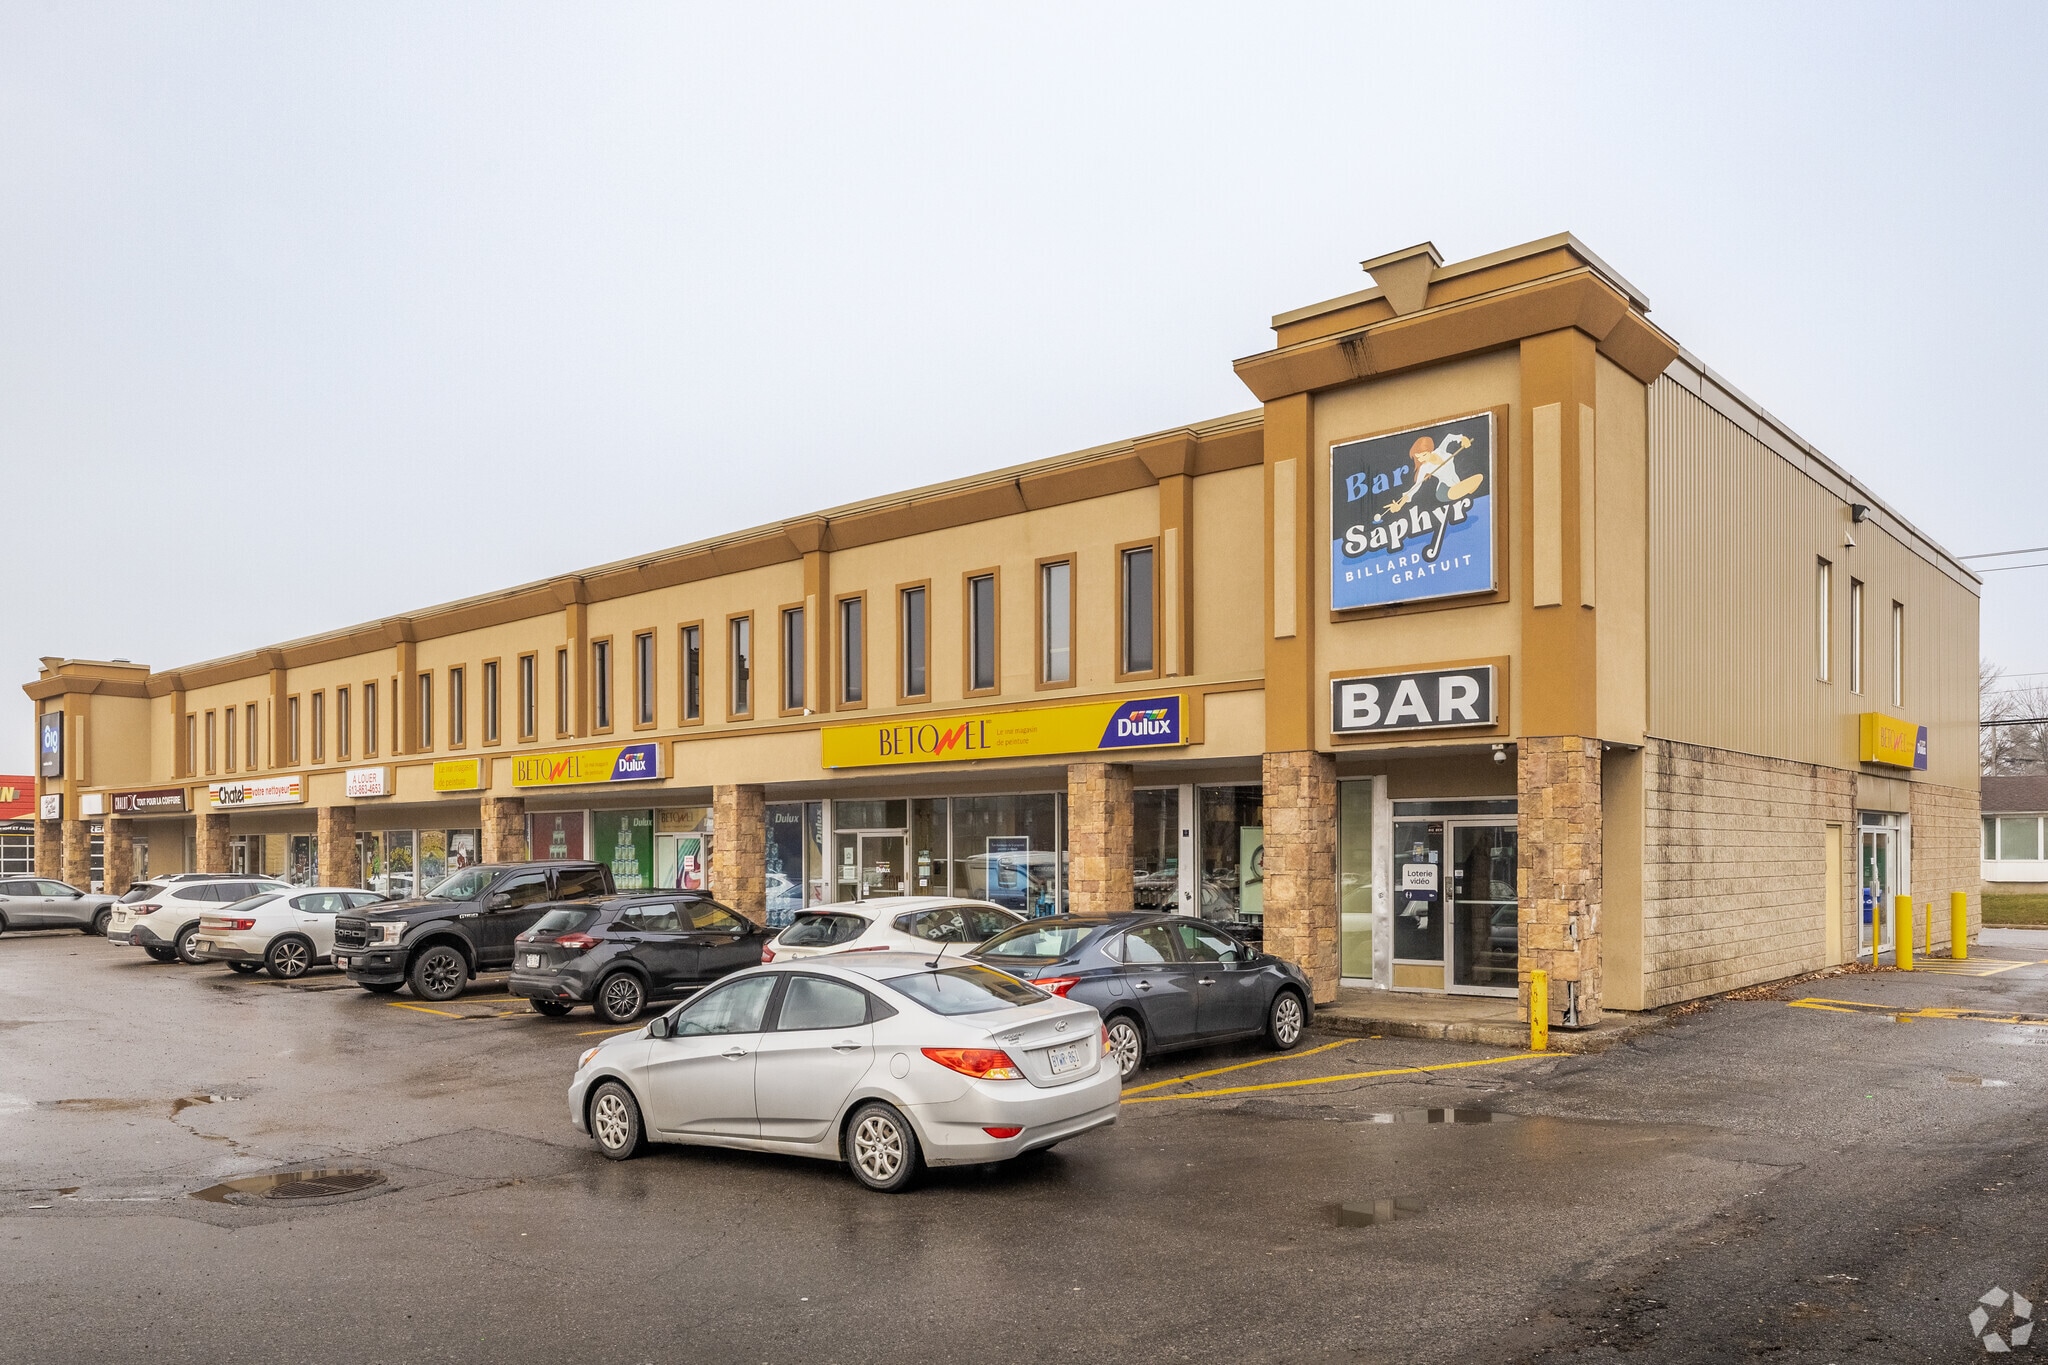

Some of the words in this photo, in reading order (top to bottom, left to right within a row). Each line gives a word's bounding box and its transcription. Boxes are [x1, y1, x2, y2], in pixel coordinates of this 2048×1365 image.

[1345, 464, 1409, 503] Bar
[1345, 497, 1472, 560] Saphyr
[1345, 553, 1420, 582] BILLARD
[1392, 554, 1471, 584] GRATUIT
[1341, 675, 1480, 728] BAR
[1014, 726, 1038, 736] magasin
[1117, 717, 1171, 737] Dulux
[1005, 737, 1029, 747] peinture
[618, 758, 646, 772] Dulux
[357, 773, 377, 784] LOUER
[0, 787, 15, 803] N
[136, 798, 146, 806] TOUT
[146, 797, 157, 806] POUR
[156, 797, 162, 805] LA
[162, 795, 181, 805] COIFFURE
[218, 784, 245, 805] Chatel
[252, 787, 265, 797] votre
[265, 785, 290, 797] nettoyeur
[633, 817, 653, 827] Dulux
[775, 813, 800, 824] Dulux
[1409, 877, 1430, 885] vidéo
